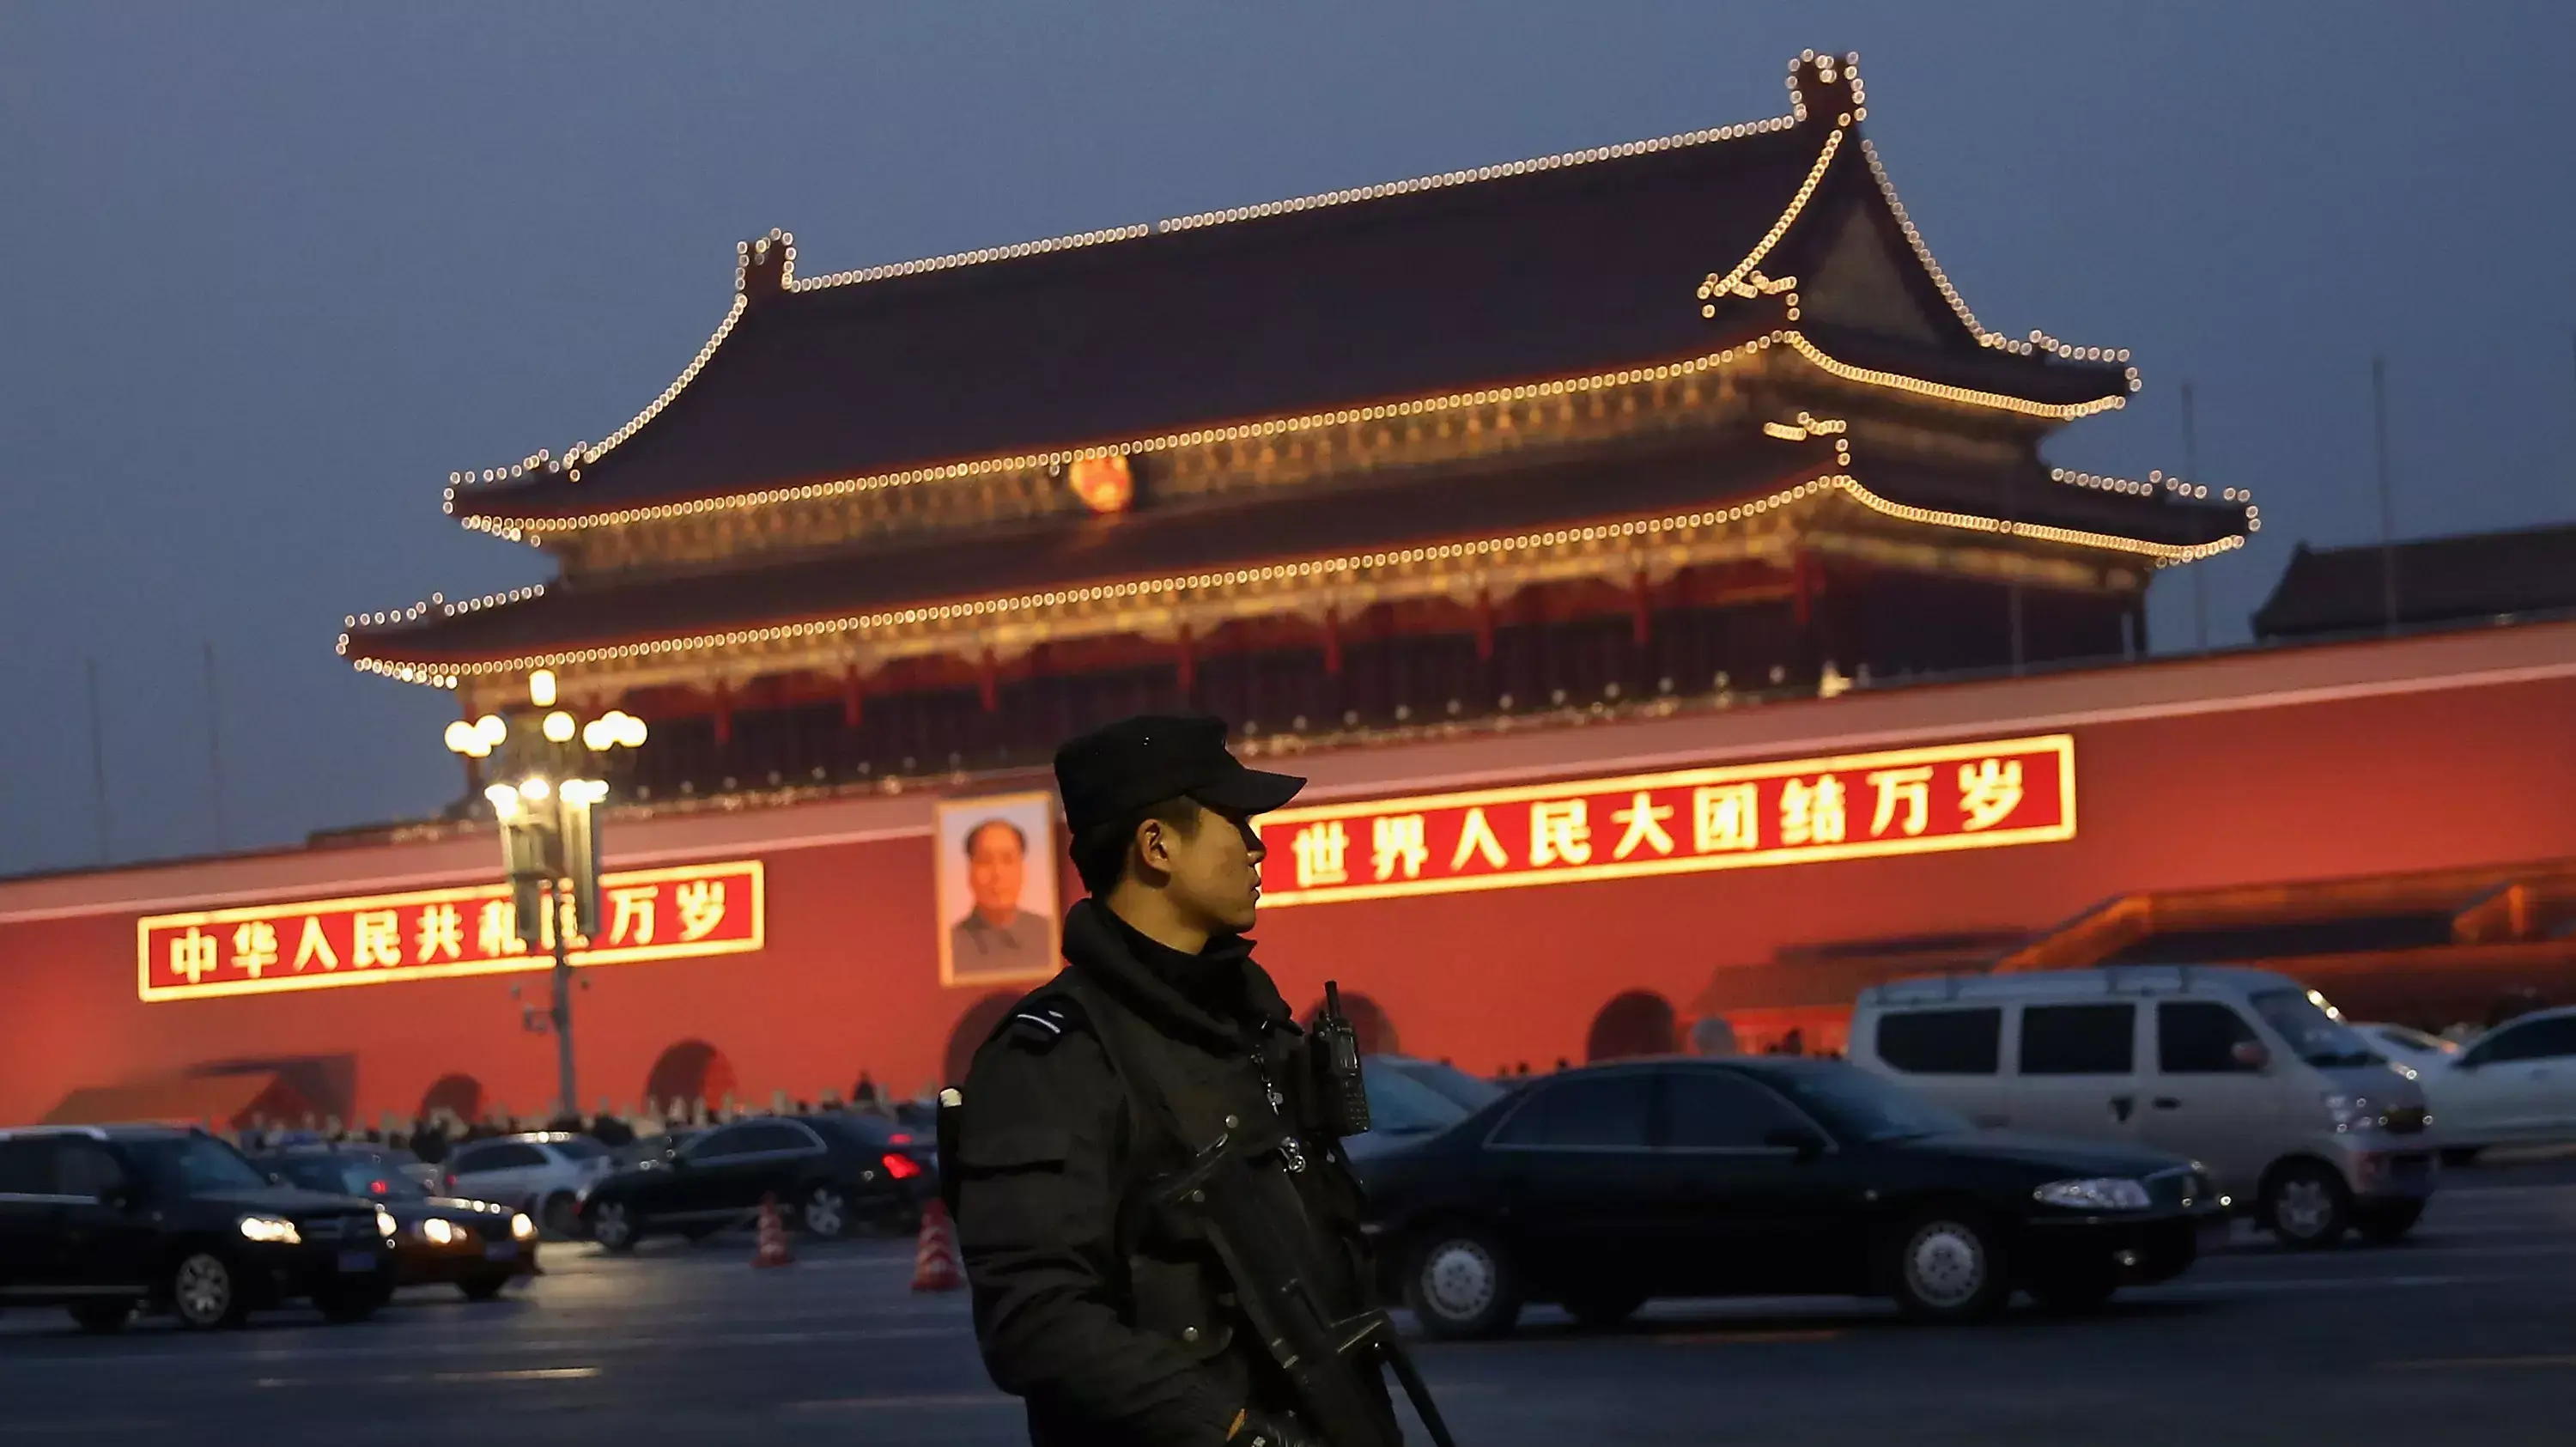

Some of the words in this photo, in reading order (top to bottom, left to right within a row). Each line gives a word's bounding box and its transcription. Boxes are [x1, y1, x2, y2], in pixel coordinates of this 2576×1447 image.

[1292, 758, 2024, 888] 世界人民大团结万岁
